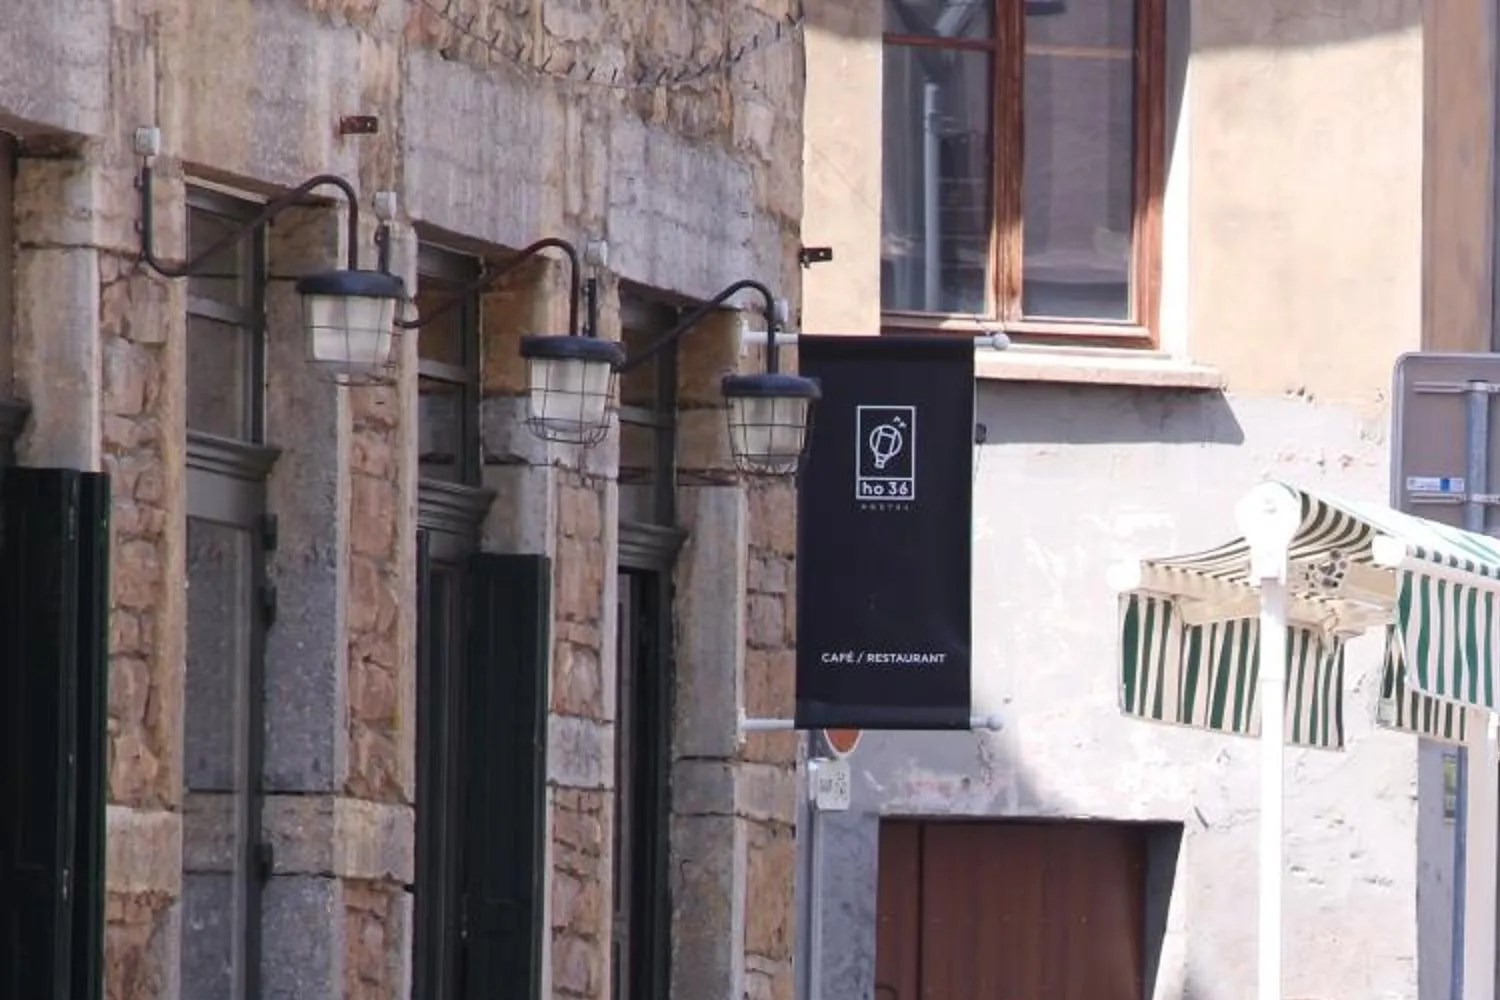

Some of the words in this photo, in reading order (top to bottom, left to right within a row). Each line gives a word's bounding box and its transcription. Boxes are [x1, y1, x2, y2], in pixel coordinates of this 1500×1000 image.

[863, 481, 884, 495] ho
[888, 481, 908, 495] 36
[821, 651, 854, 663] CAFÉ
[867, 653, 946, 663] RESTAURANT
